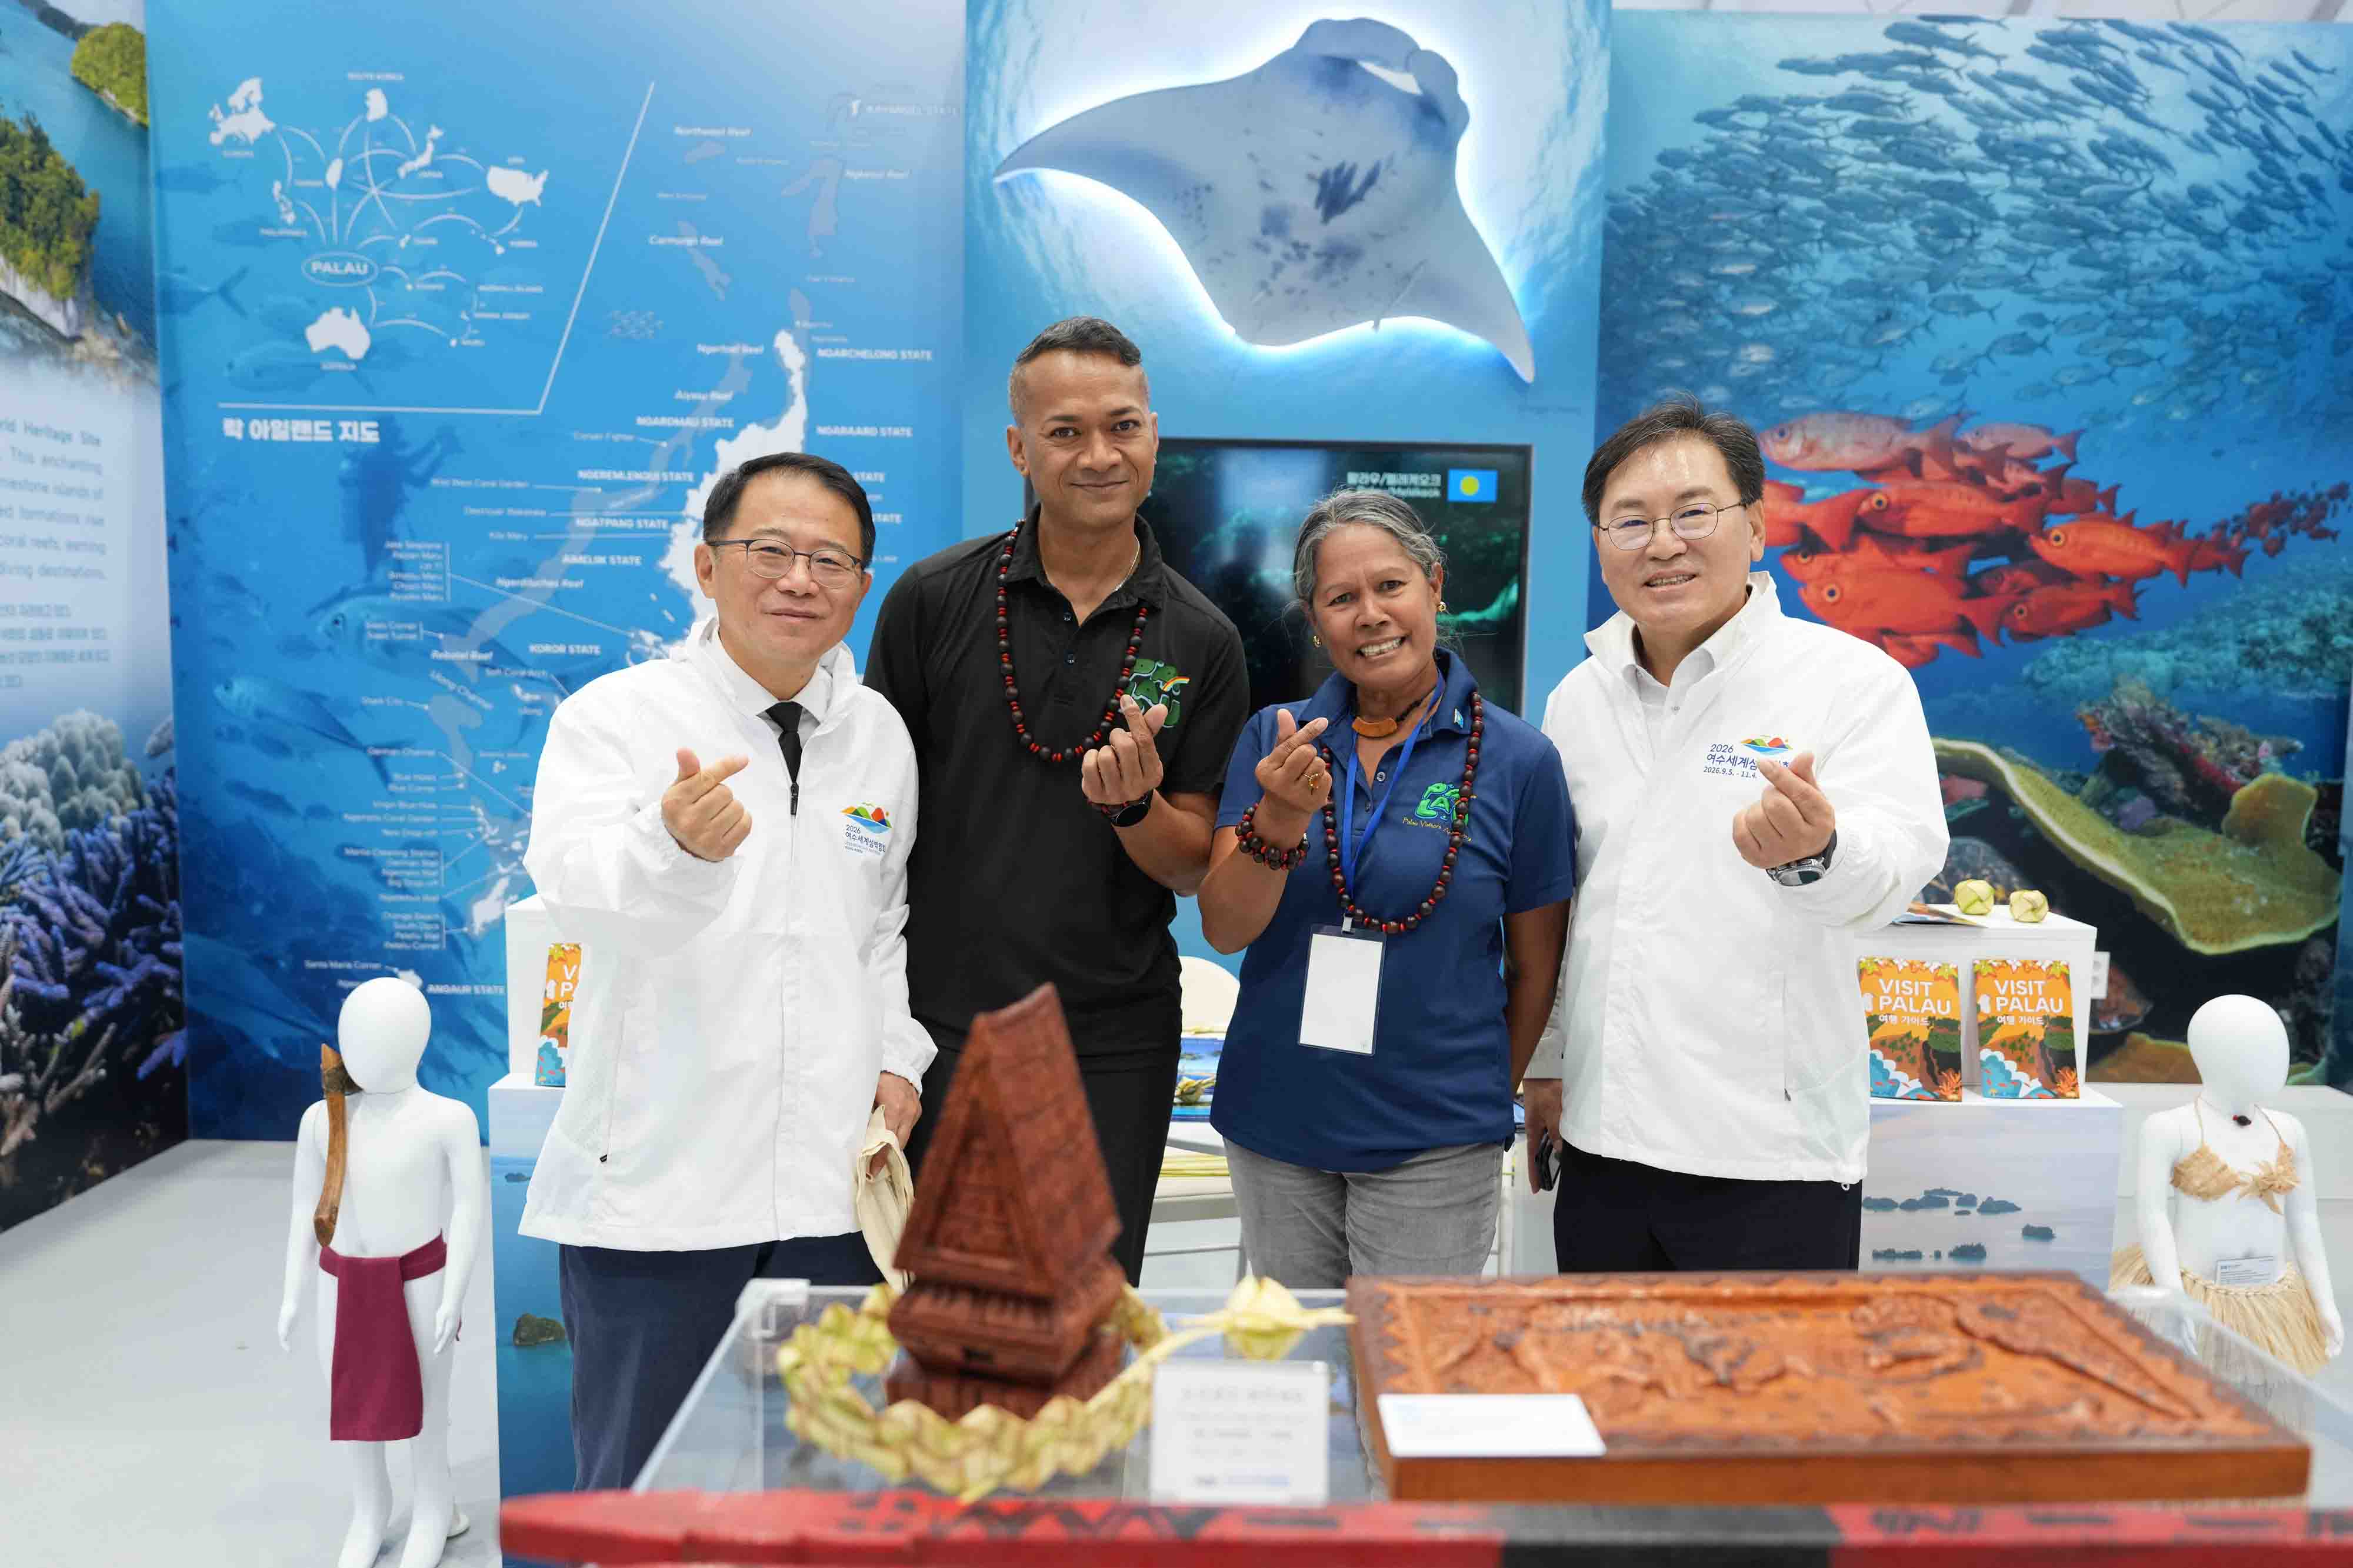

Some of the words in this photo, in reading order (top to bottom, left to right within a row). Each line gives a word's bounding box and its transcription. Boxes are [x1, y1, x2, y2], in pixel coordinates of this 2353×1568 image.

[311, 261, 368, 275] PALAU
[901, 349, 932, 361] STATE
[702, 416, 734, 428] STATE
[249, 418, 333, 441] 아일랜드
[338, 420, 379, 442] 지도
[880, 426, 912, 438] STATE
[662, 471, 695, 482] STATE
[636, 519, 669, 529] STATE
[609, 555, 642, 565] STATE
[568, 644, 601, 655] STATE
[1710, 744, 1734, 753] 2026
[1704, 766, 1735, 777] 2026.9.5.
[846, 824, 861, 834] 2026
[1878, 978, 1934, 997] VISIT
[1995, 979, 2045, 996] VISIT
[1879, 995, 1951, 1016] PALAU
[1996, 996, 2064, 1013] PALAU
[1901, 1016, 1930, 1027] 가이드
[2018, 1016, 2044, 1026] 가이드
